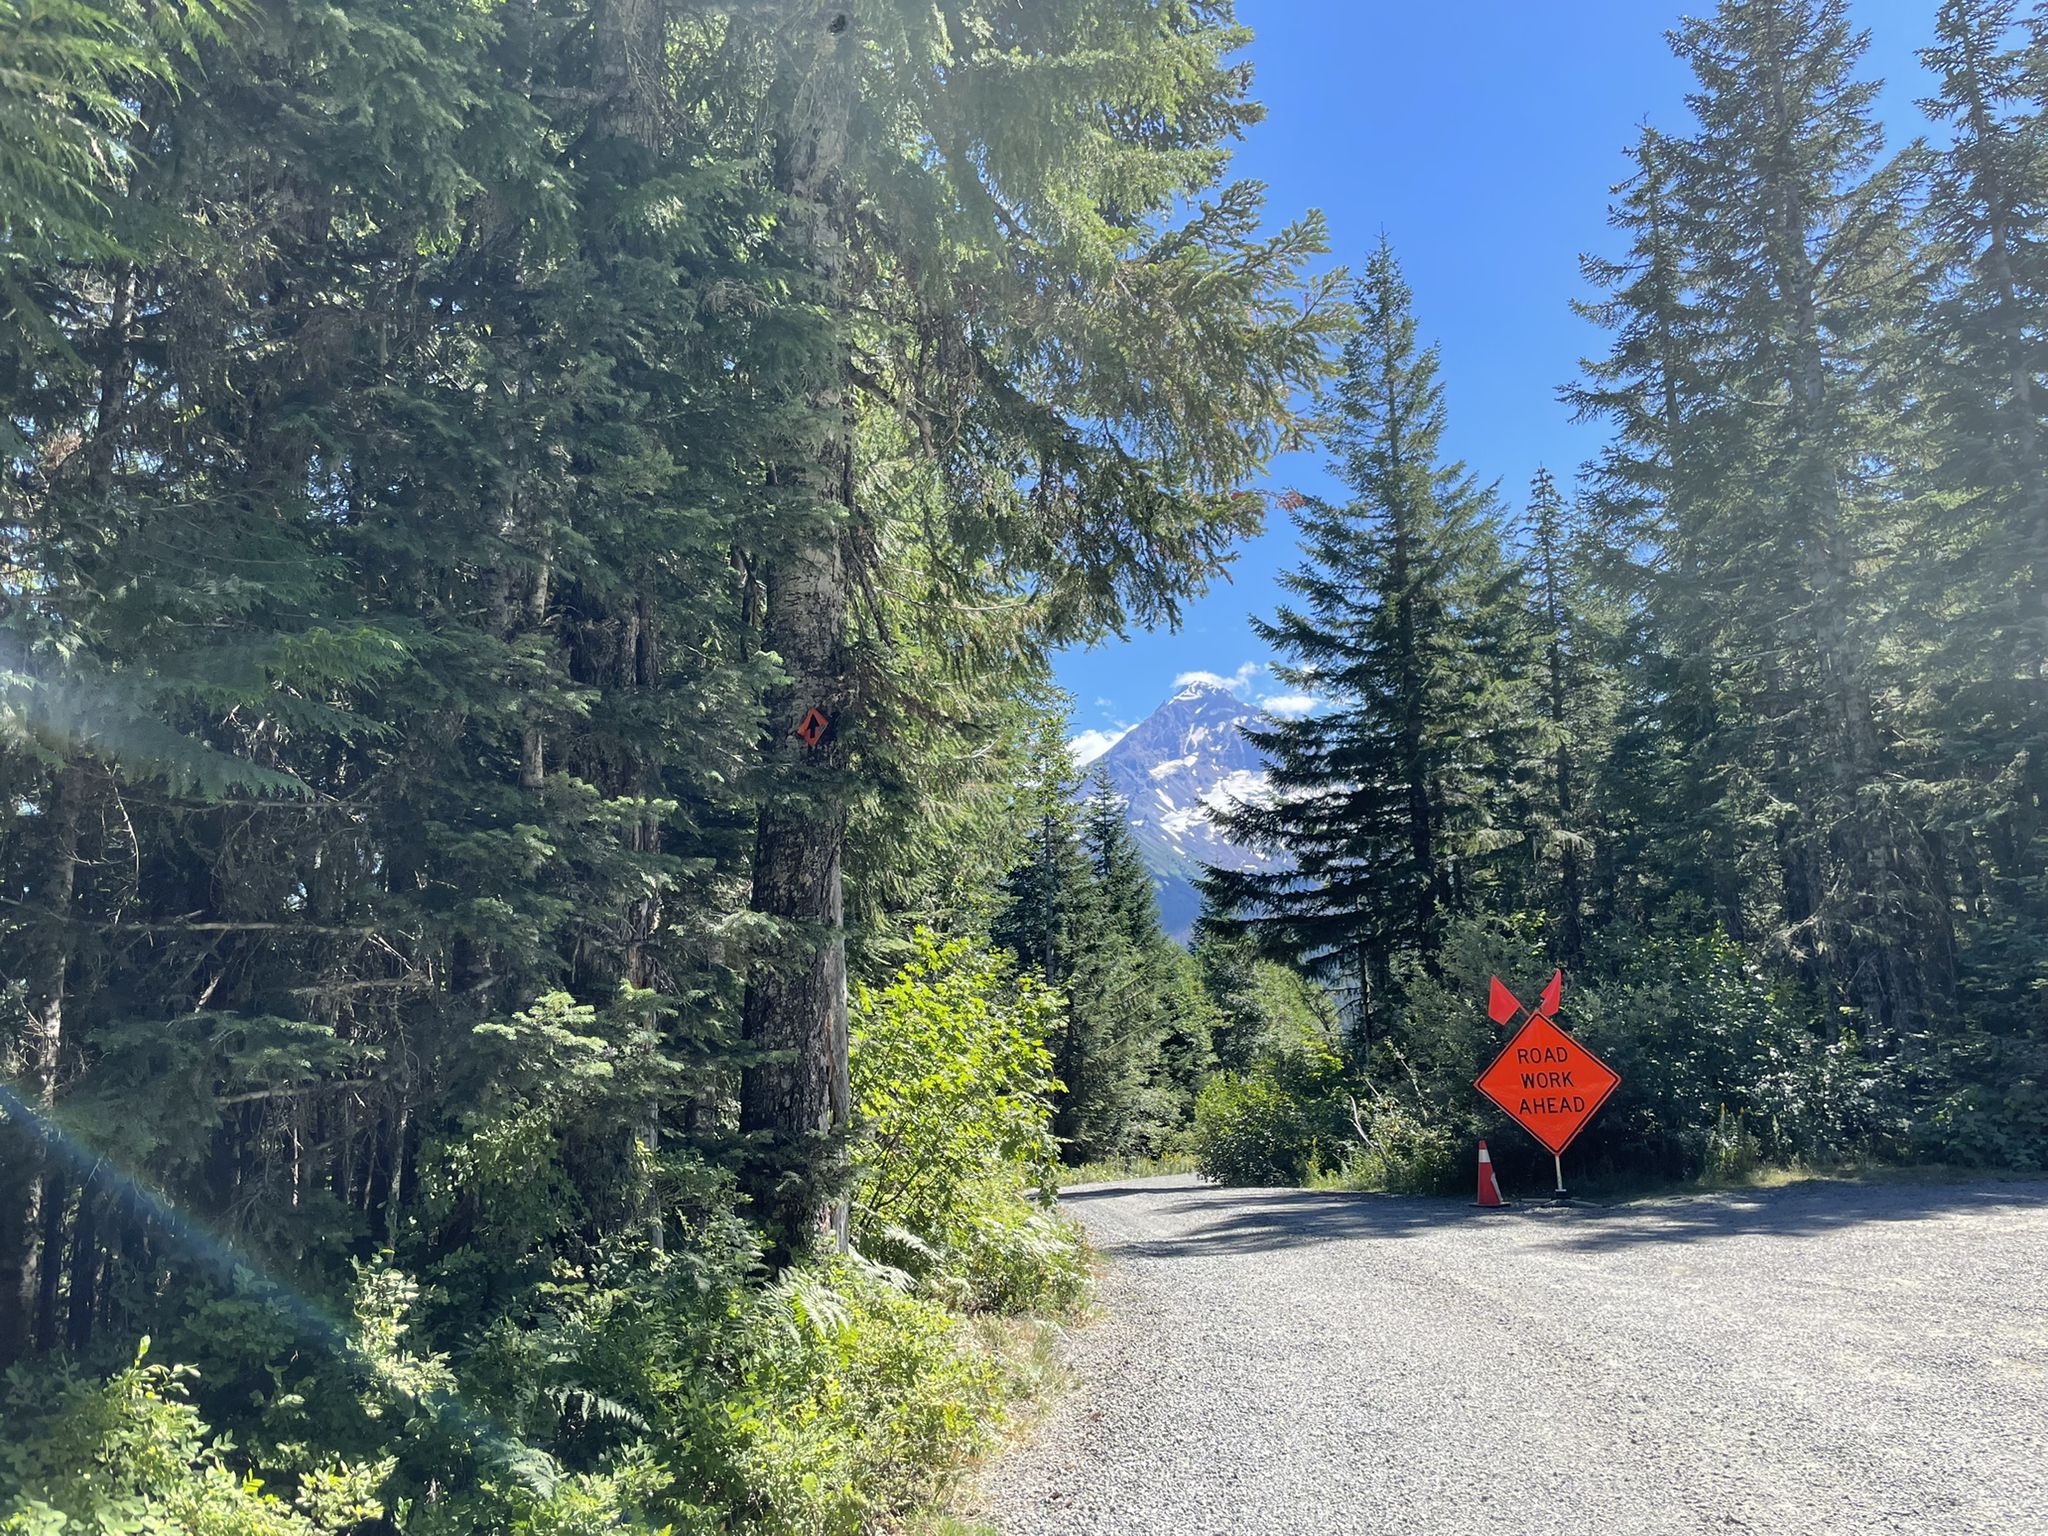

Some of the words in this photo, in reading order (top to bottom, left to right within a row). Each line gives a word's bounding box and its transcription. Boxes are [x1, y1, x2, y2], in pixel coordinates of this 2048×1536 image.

[1517, 1047, 1568, 1064] ROAD
[1521, 1071, 1574, 1089] WORK
[1519, 1096, 1585, 1114] AHEAD
